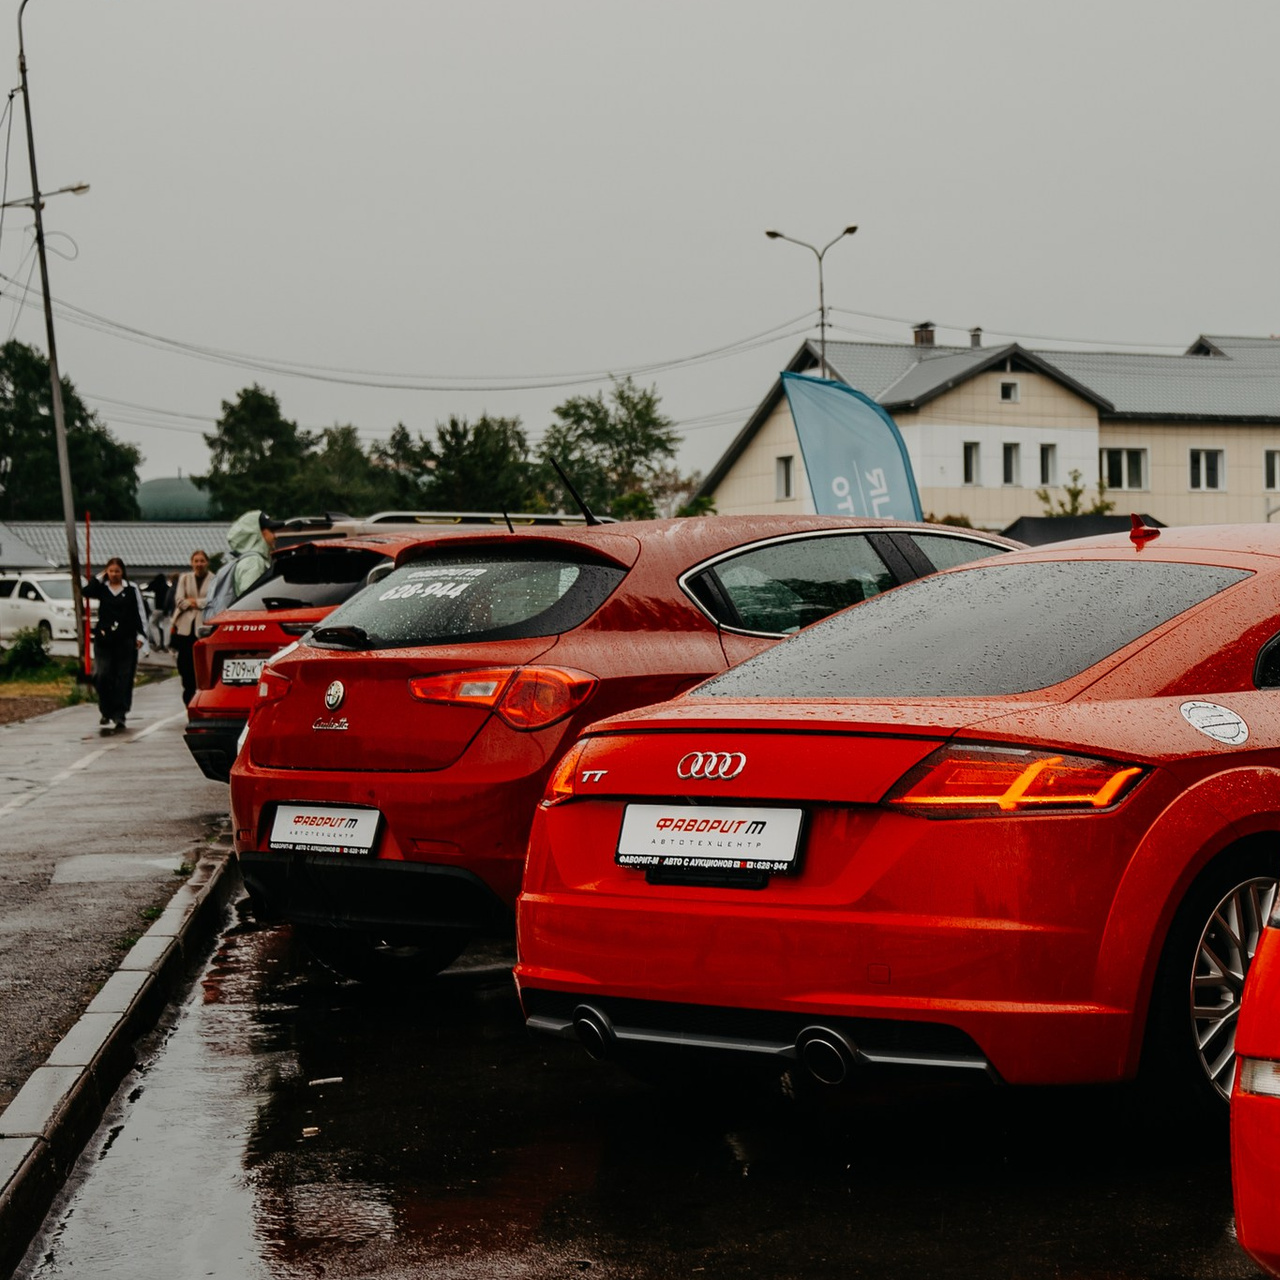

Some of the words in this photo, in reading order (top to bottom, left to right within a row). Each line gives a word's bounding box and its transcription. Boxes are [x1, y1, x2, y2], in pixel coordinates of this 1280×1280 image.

[379, 582, 472, 601] 628-944
[582, 770, 608, 783] TT
[656, 817, 748, 834] ФАВОРИТ
[290, 830, 355, 838] АВТОТЕХЦЕНТР
[651, 838, 762, 849] АВТОТЕХЦЕНТР
[619, 855, 660, 865] ФАВОРИТ-М
[663, 857, 683, 866] АВТО
[683, 858, 690, 866] С
[689, 858, 733, 868] АУКЦИОНОВ
